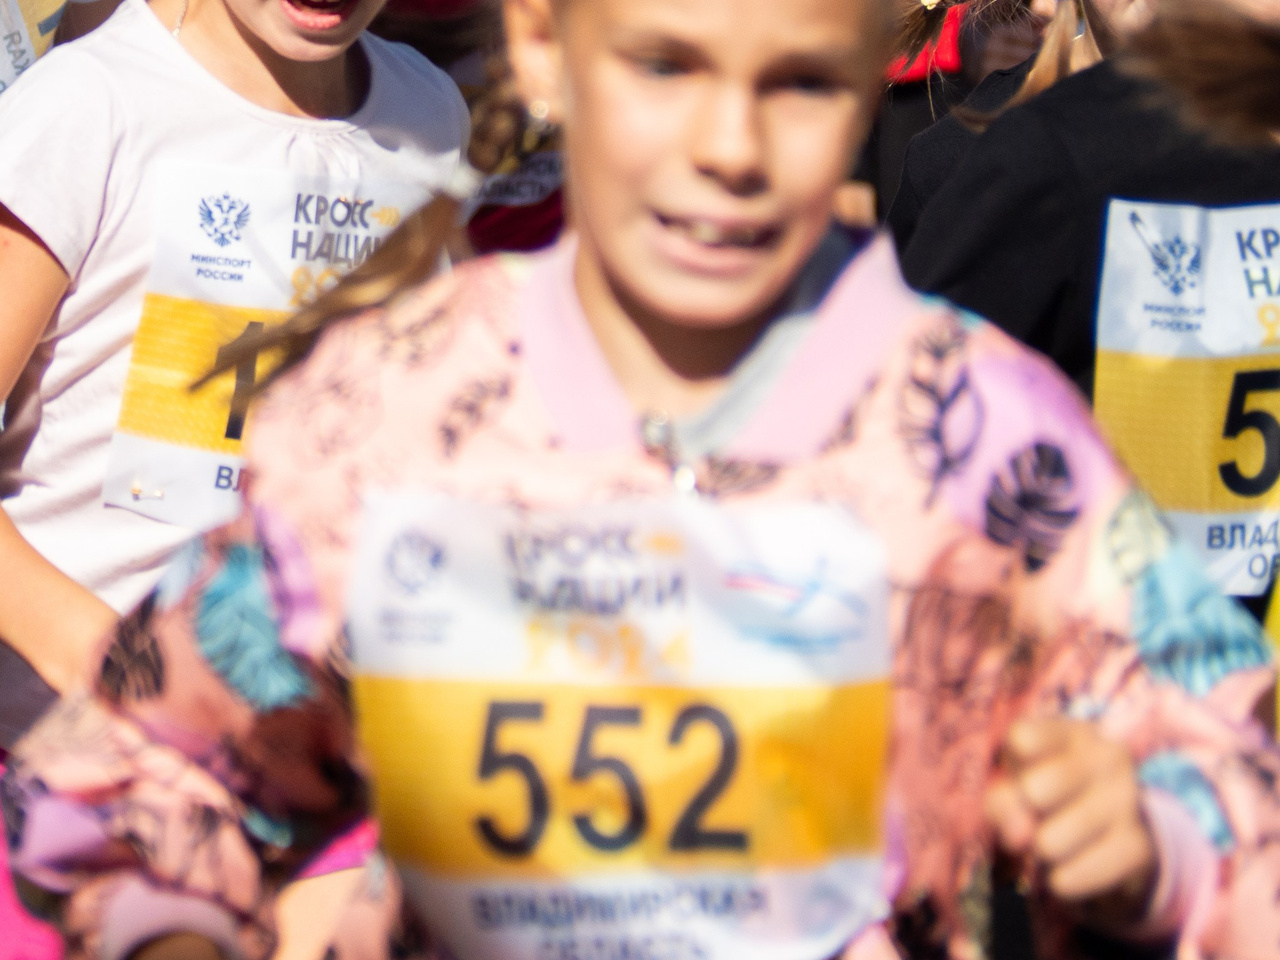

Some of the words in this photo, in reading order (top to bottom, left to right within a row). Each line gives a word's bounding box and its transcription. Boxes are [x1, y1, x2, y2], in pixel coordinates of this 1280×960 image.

[294, 193, 375, 230] КРОСС
[191, 253, 251, 270] МИНСПОРТ
[195, 267, 244, 283] РОССИИ
[1218, 368, 1280, 499] 5
[475, 698, 750, 862] 552
